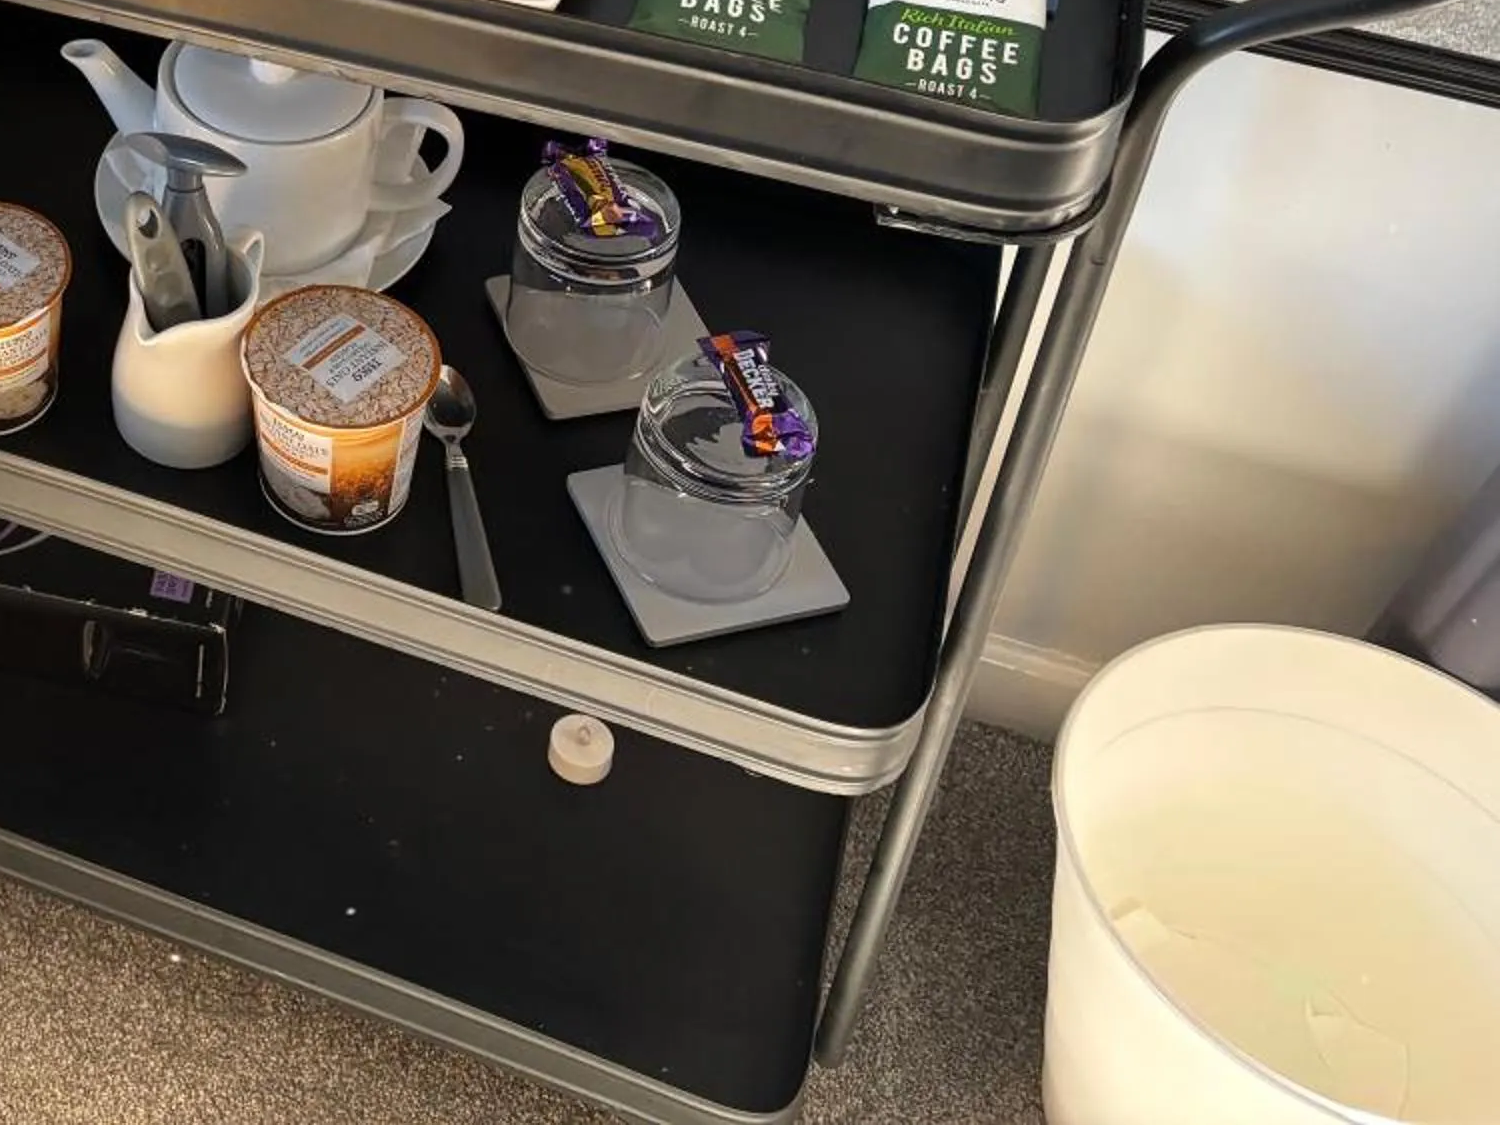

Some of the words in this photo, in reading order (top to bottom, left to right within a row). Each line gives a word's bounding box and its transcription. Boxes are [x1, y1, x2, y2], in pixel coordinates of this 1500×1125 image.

[690, 15, 735, 36] ROAST
[739, 25, 748, 37] 4
[901, 8, 945, 27] Rich
[948, 14, 1018, 37] Italian
[893, 23, 1020, 65] COFFEE
[906, 48, 997, 84] BAGS
[917, 78, 965, 98] ROAST
[968, 87, 978, 100] 4
[732, 348, 775, 409] DECKER
